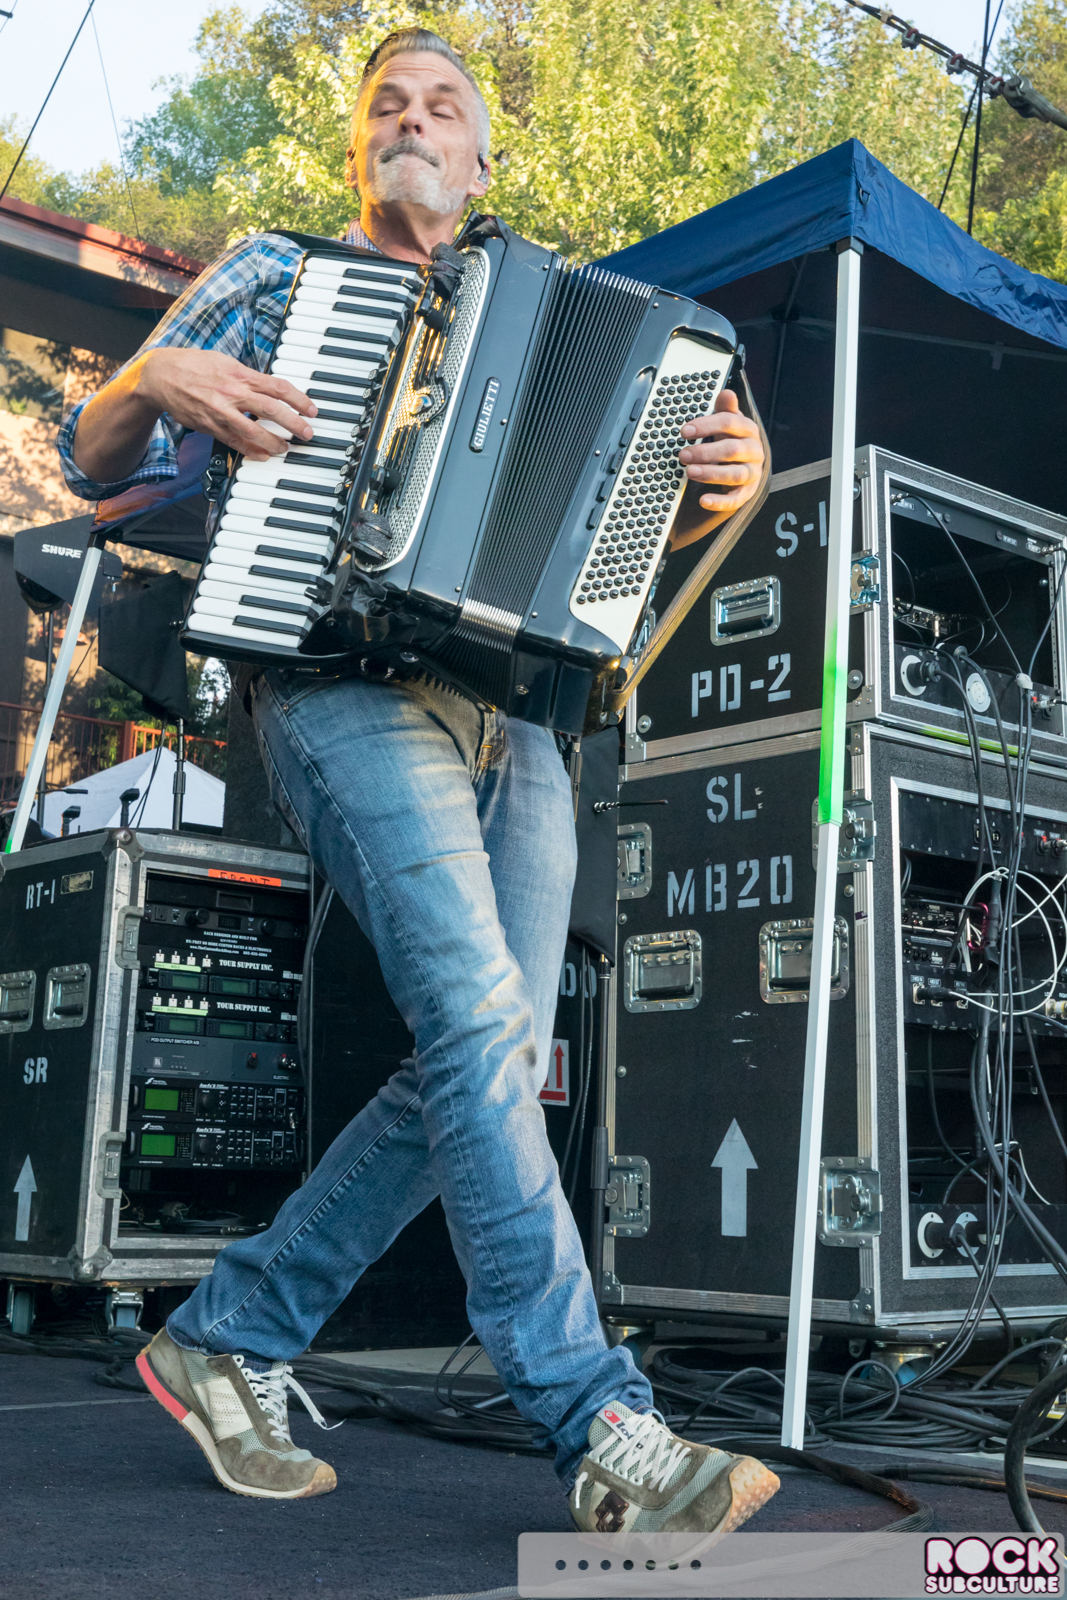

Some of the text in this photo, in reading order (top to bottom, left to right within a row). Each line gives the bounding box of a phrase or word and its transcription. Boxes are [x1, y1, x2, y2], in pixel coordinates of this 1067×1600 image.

[473, 380, 499, 447] GIULIETTI
[41, 543, 83, 559] SHURE
[691, 653, 791, 718] PD-2
[667, 855, 793, 918] MB20
[219, 959, 274, 972] TOUR SUPPLY INC.
[216, 1002, 272, 1014] TOUR SUPPLY INC.
[23, 1056, 49, 1085] SR
